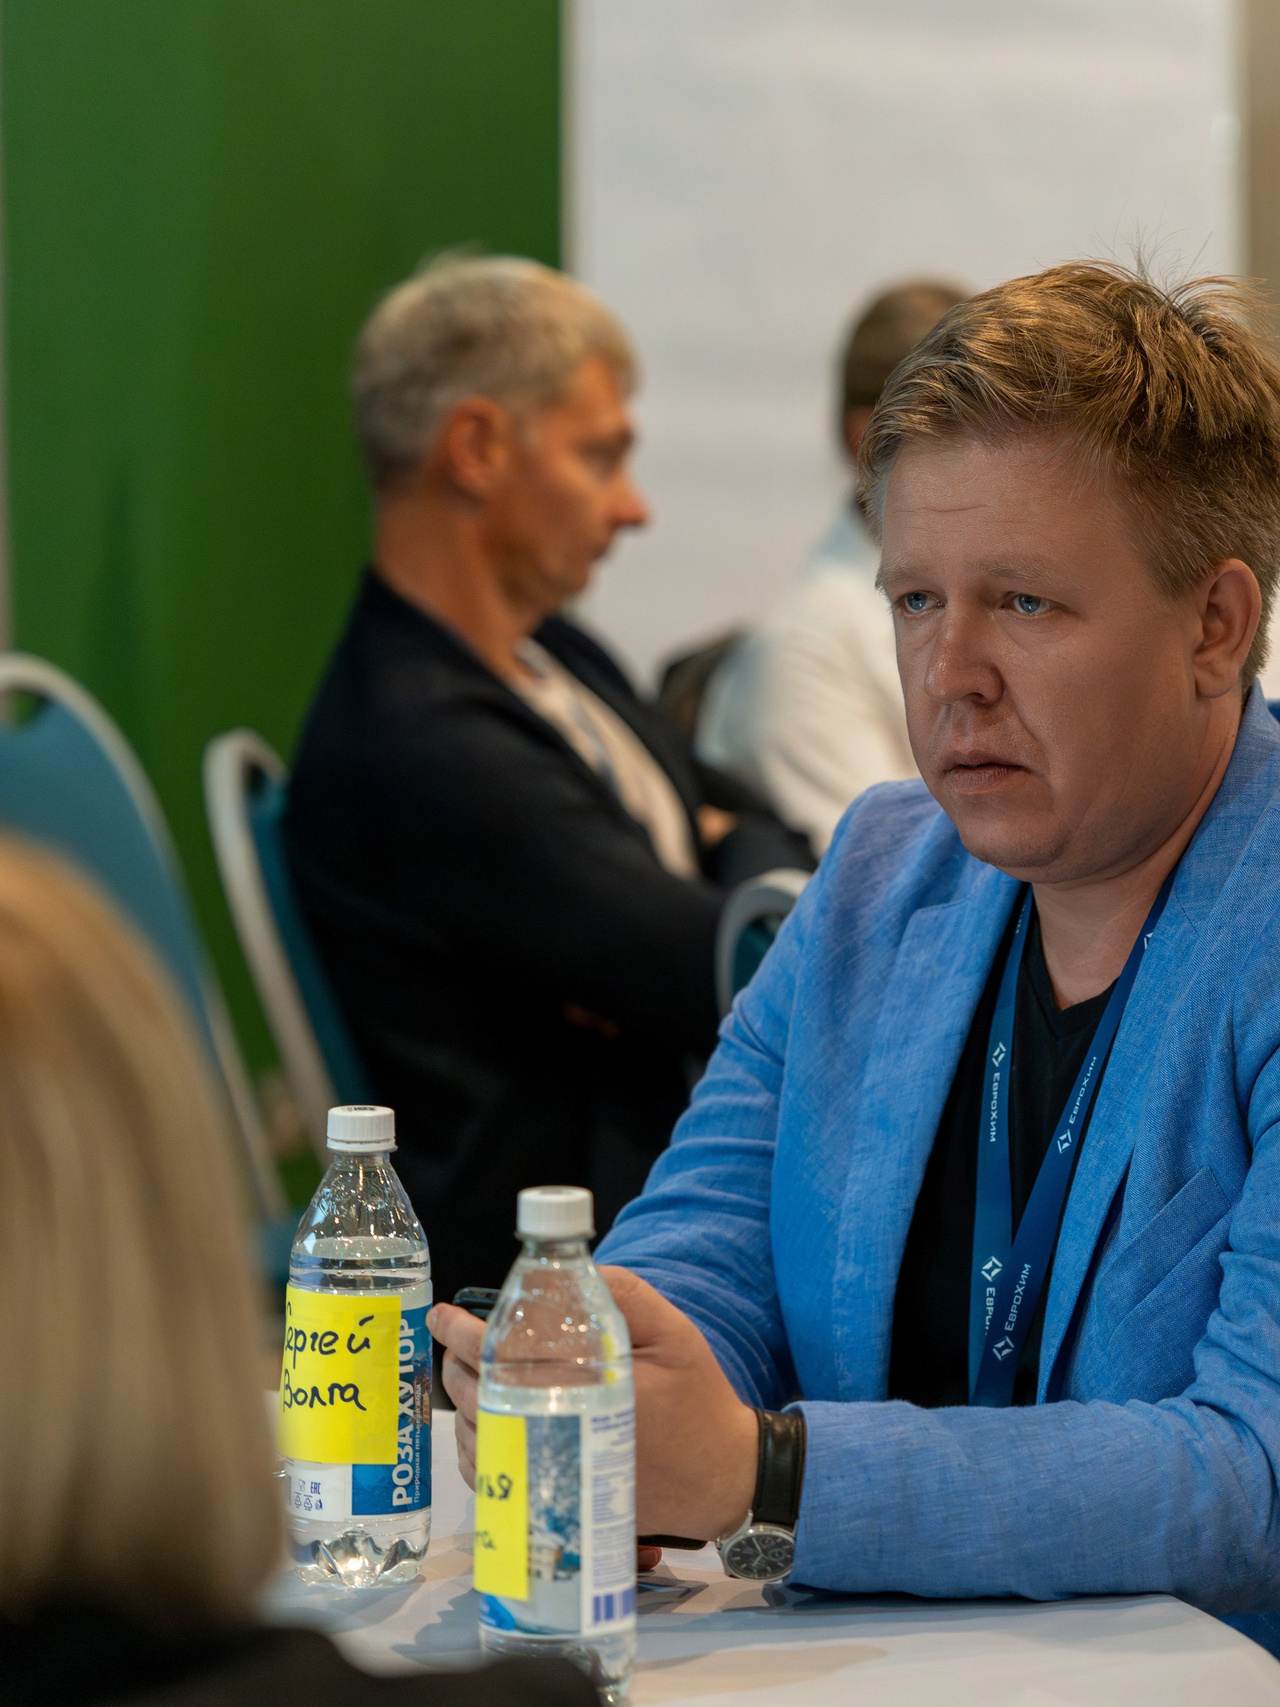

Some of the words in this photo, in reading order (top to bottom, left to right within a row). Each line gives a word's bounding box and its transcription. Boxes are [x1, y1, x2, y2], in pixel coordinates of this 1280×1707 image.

[283, 1368, 367, 1413] Волга
[392, 1423, 414, 1506] РОЗА
[413, 1452, 421, 1503] Природная
